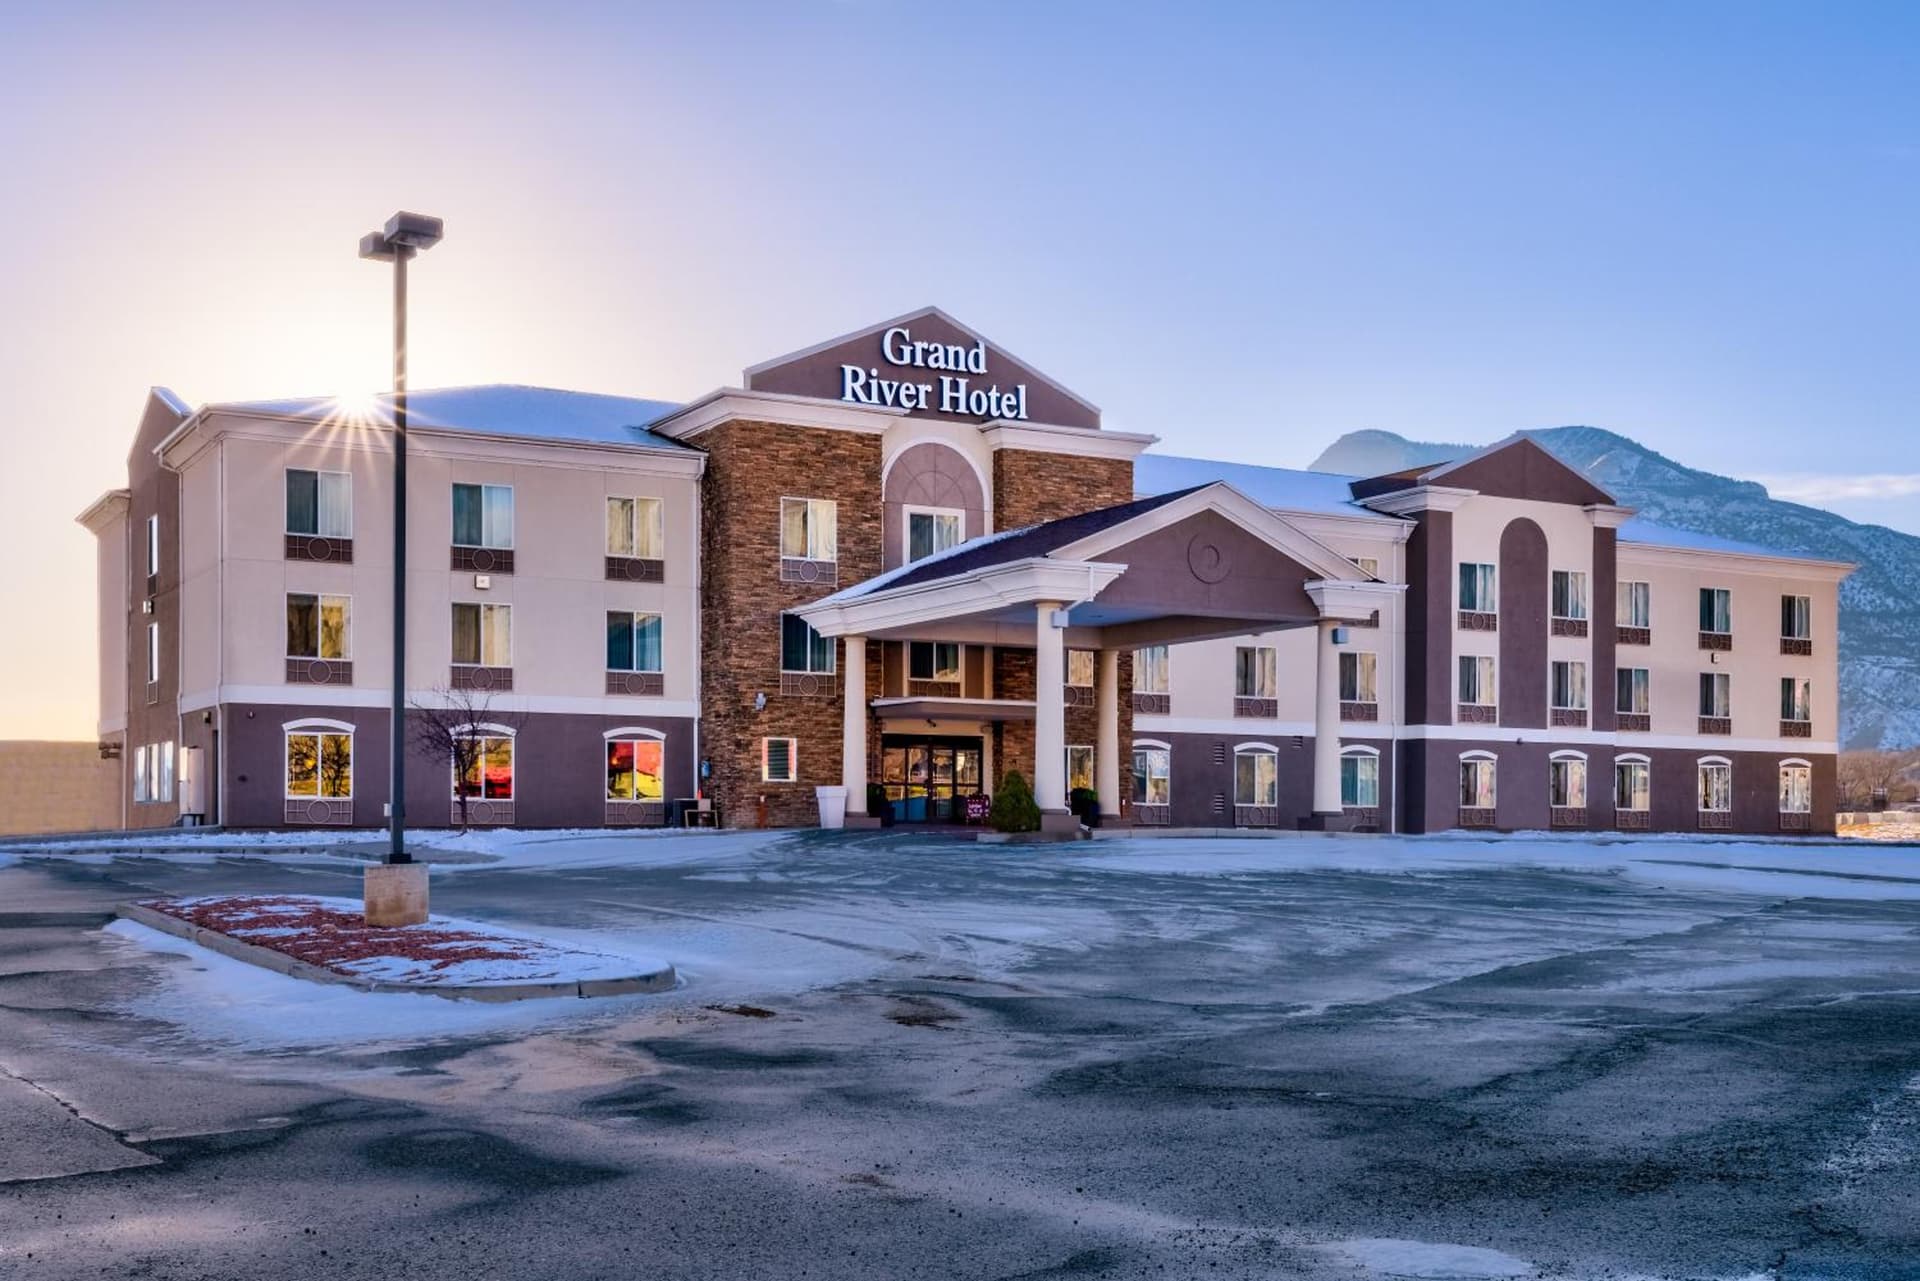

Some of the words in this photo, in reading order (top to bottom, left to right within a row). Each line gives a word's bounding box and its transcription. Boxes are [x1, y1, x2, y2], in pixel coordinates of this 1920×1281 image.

[883, 328, 987, 374] Grand
[841, 365, 932, 409] River
[939, 376, 1028, 419] Hotel
